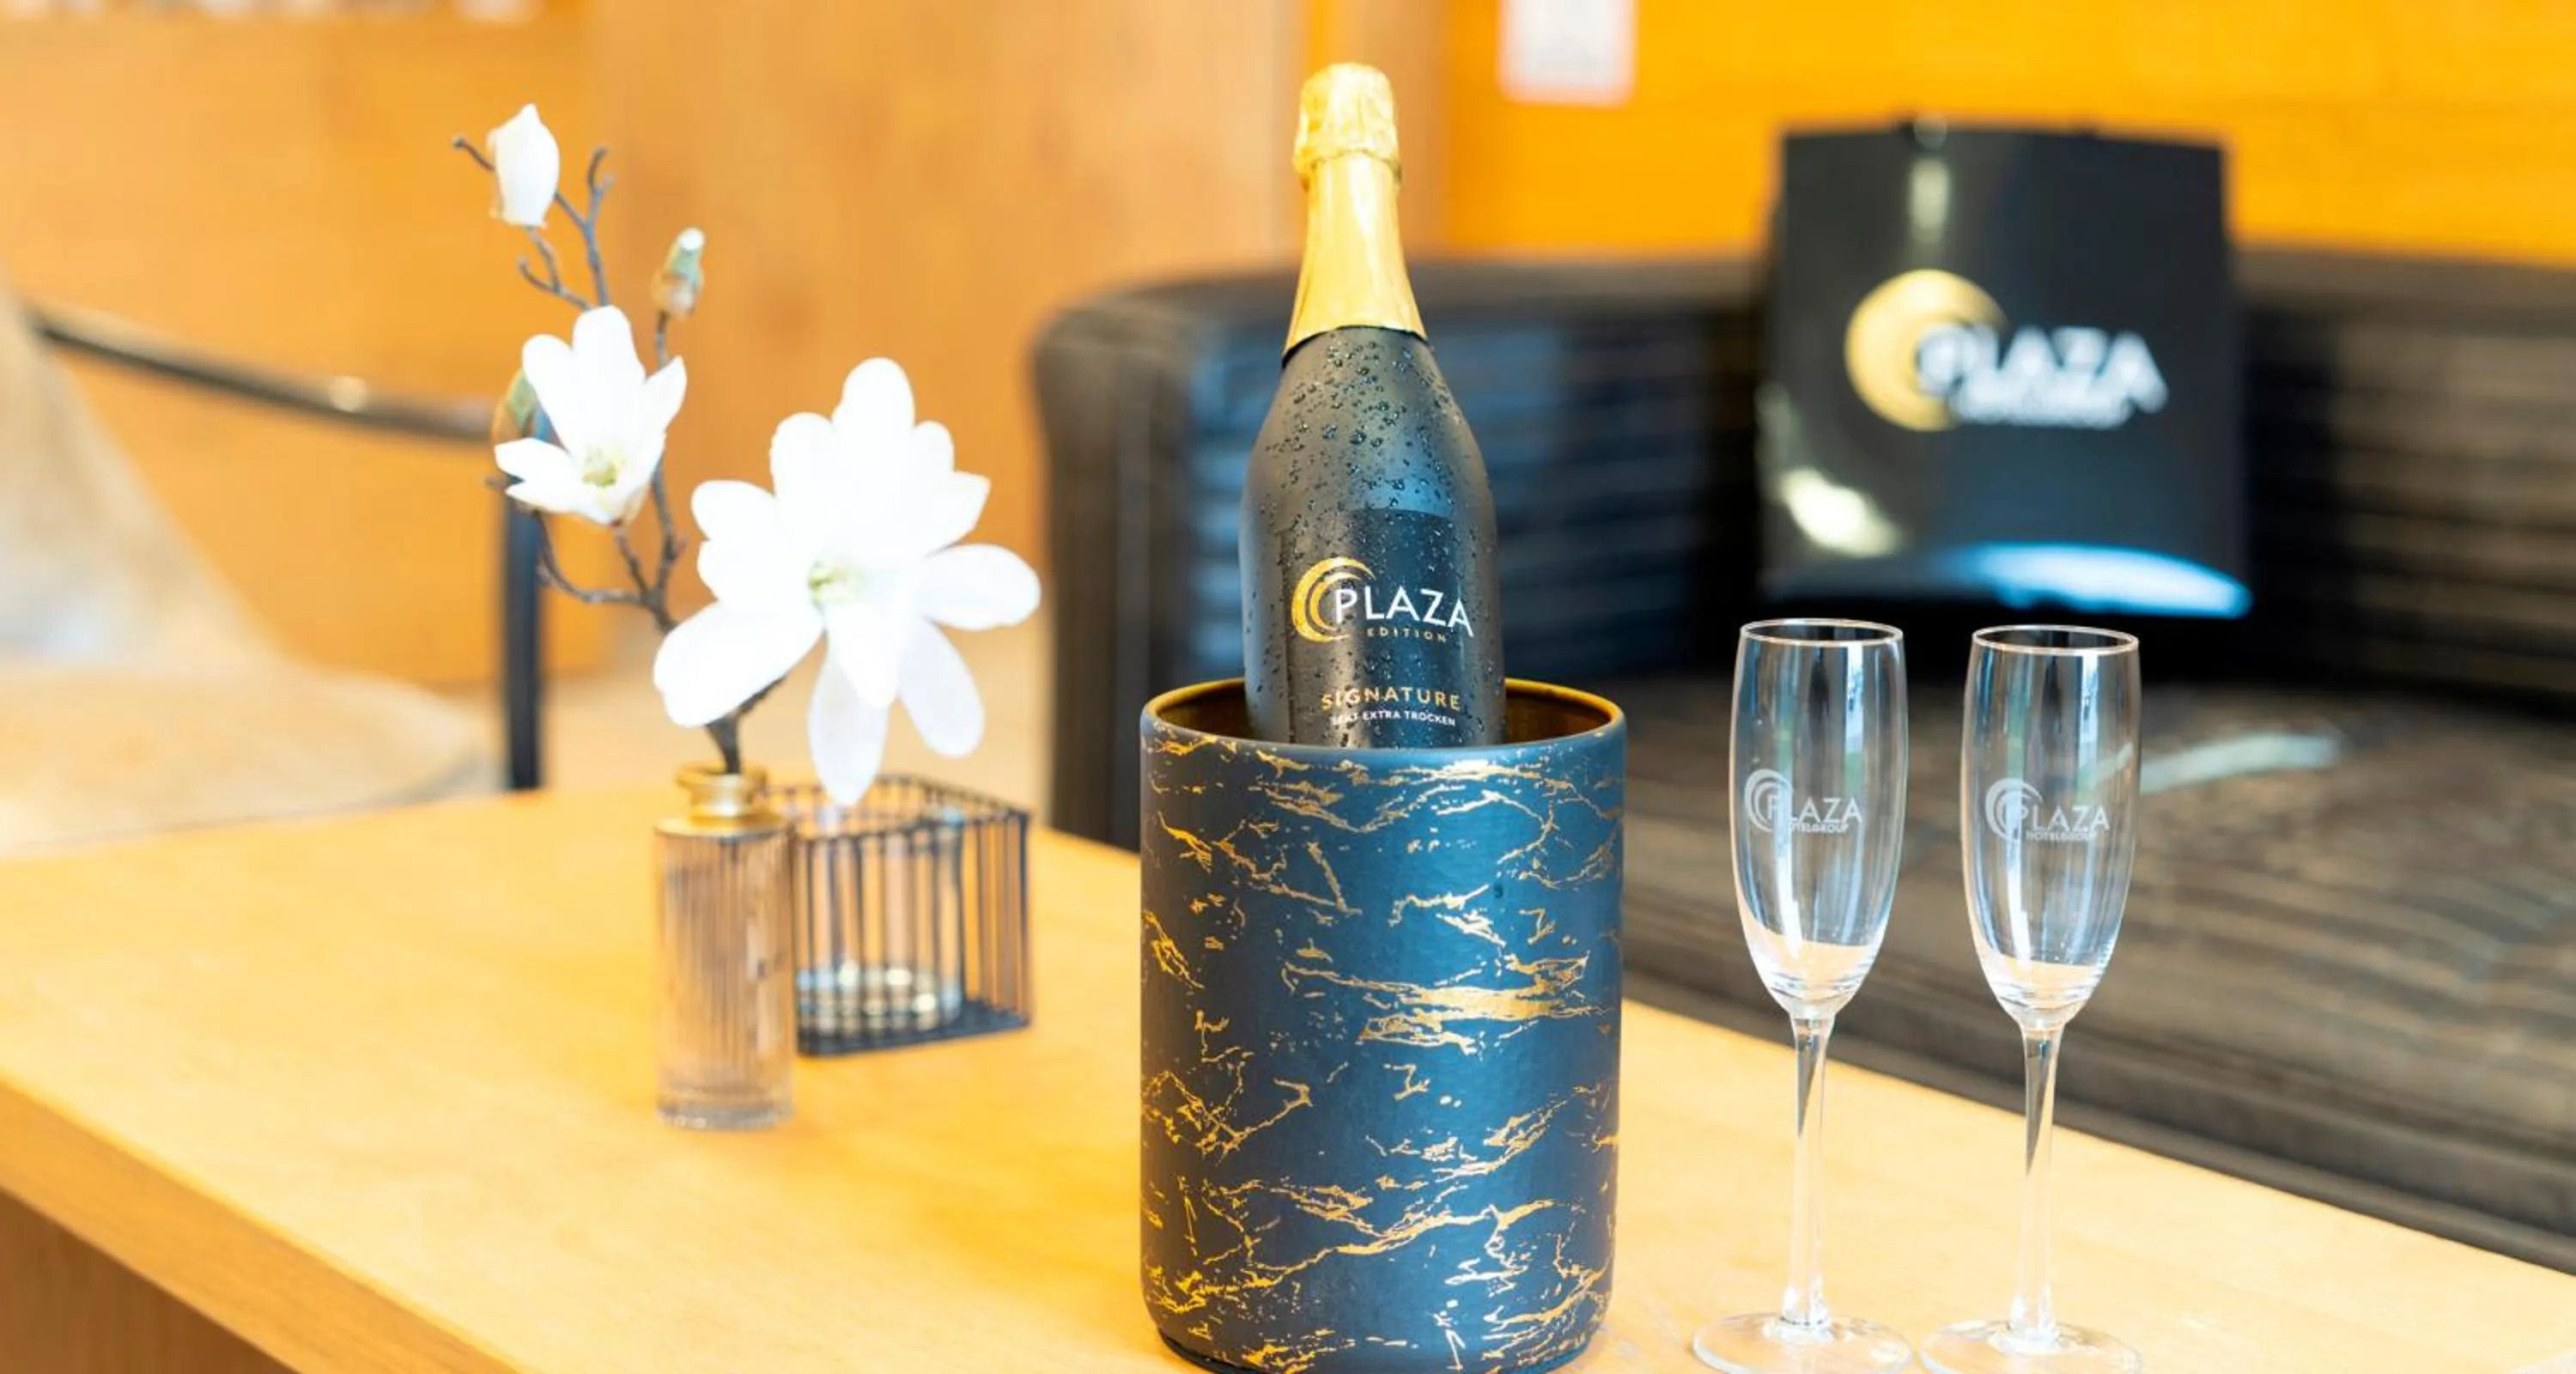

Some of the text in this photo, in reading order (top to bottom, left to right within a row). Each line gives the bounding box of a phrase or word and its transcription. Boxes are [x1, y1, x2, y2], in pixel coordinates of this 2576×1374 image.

[1334, 586, 1474, 637] PLAZA
[1367, 626, 1447, 643] EDITION
[1321, 687, 1461, 712] SIGNATURE
[1362, 710, 1401, 721] EXTRA
[1404, 710, 1456, 727] TROCKEN
[1767, 796, 1863, 823] PAZA
